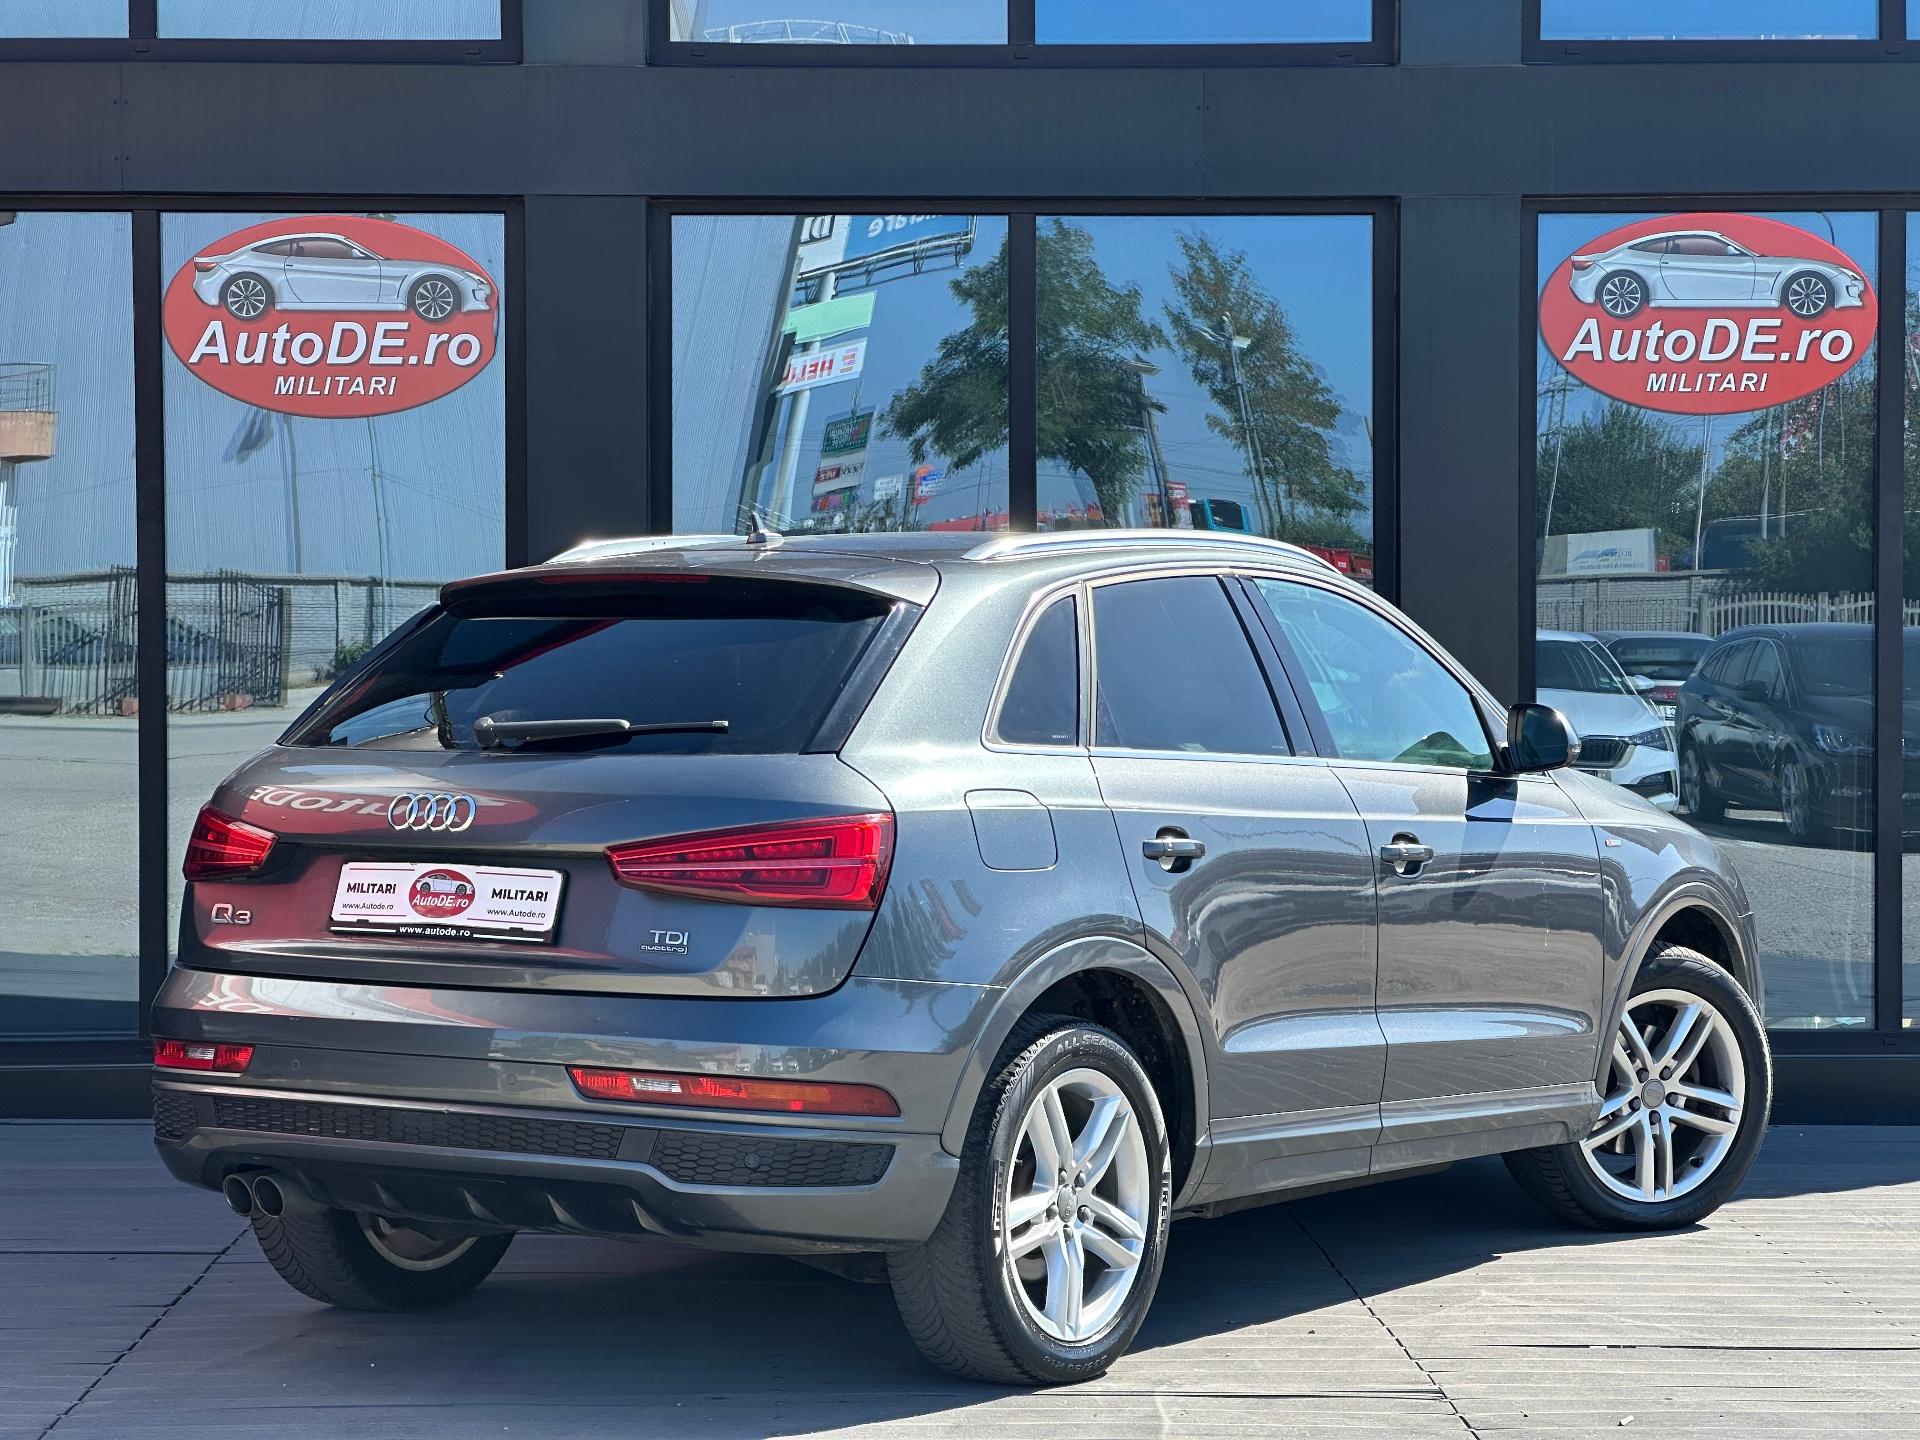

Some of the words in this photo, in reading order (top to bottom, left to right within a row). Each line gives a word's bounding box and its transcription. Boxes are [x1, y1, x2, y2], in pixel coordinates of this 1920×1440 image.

[188, 320, 481, 366] AutoDE.ro
[1563, 318, 1853, 363] AutoDE.ro
[274, 376, 397, 396] MILITARI
[1646, 373, 1768, 392] MILITARI
[346, 882, 397, 895] MILITARI
[491, 888, 549, 902] MILITARI
[342, 902, 394, 910] www.Autode.ro
[412, 895, 469, 908] AutoDE.ro
[210, 904, 252, 925] Q3
[487, 908, 546, 919] www.Autode.ro
[399, 926, 471, 937] www.autode.ro
[649, 930, 689, 945] TDI
[640, 945, 688, 955] quattro
[1055, 1037, 1081, 1056] ALL
